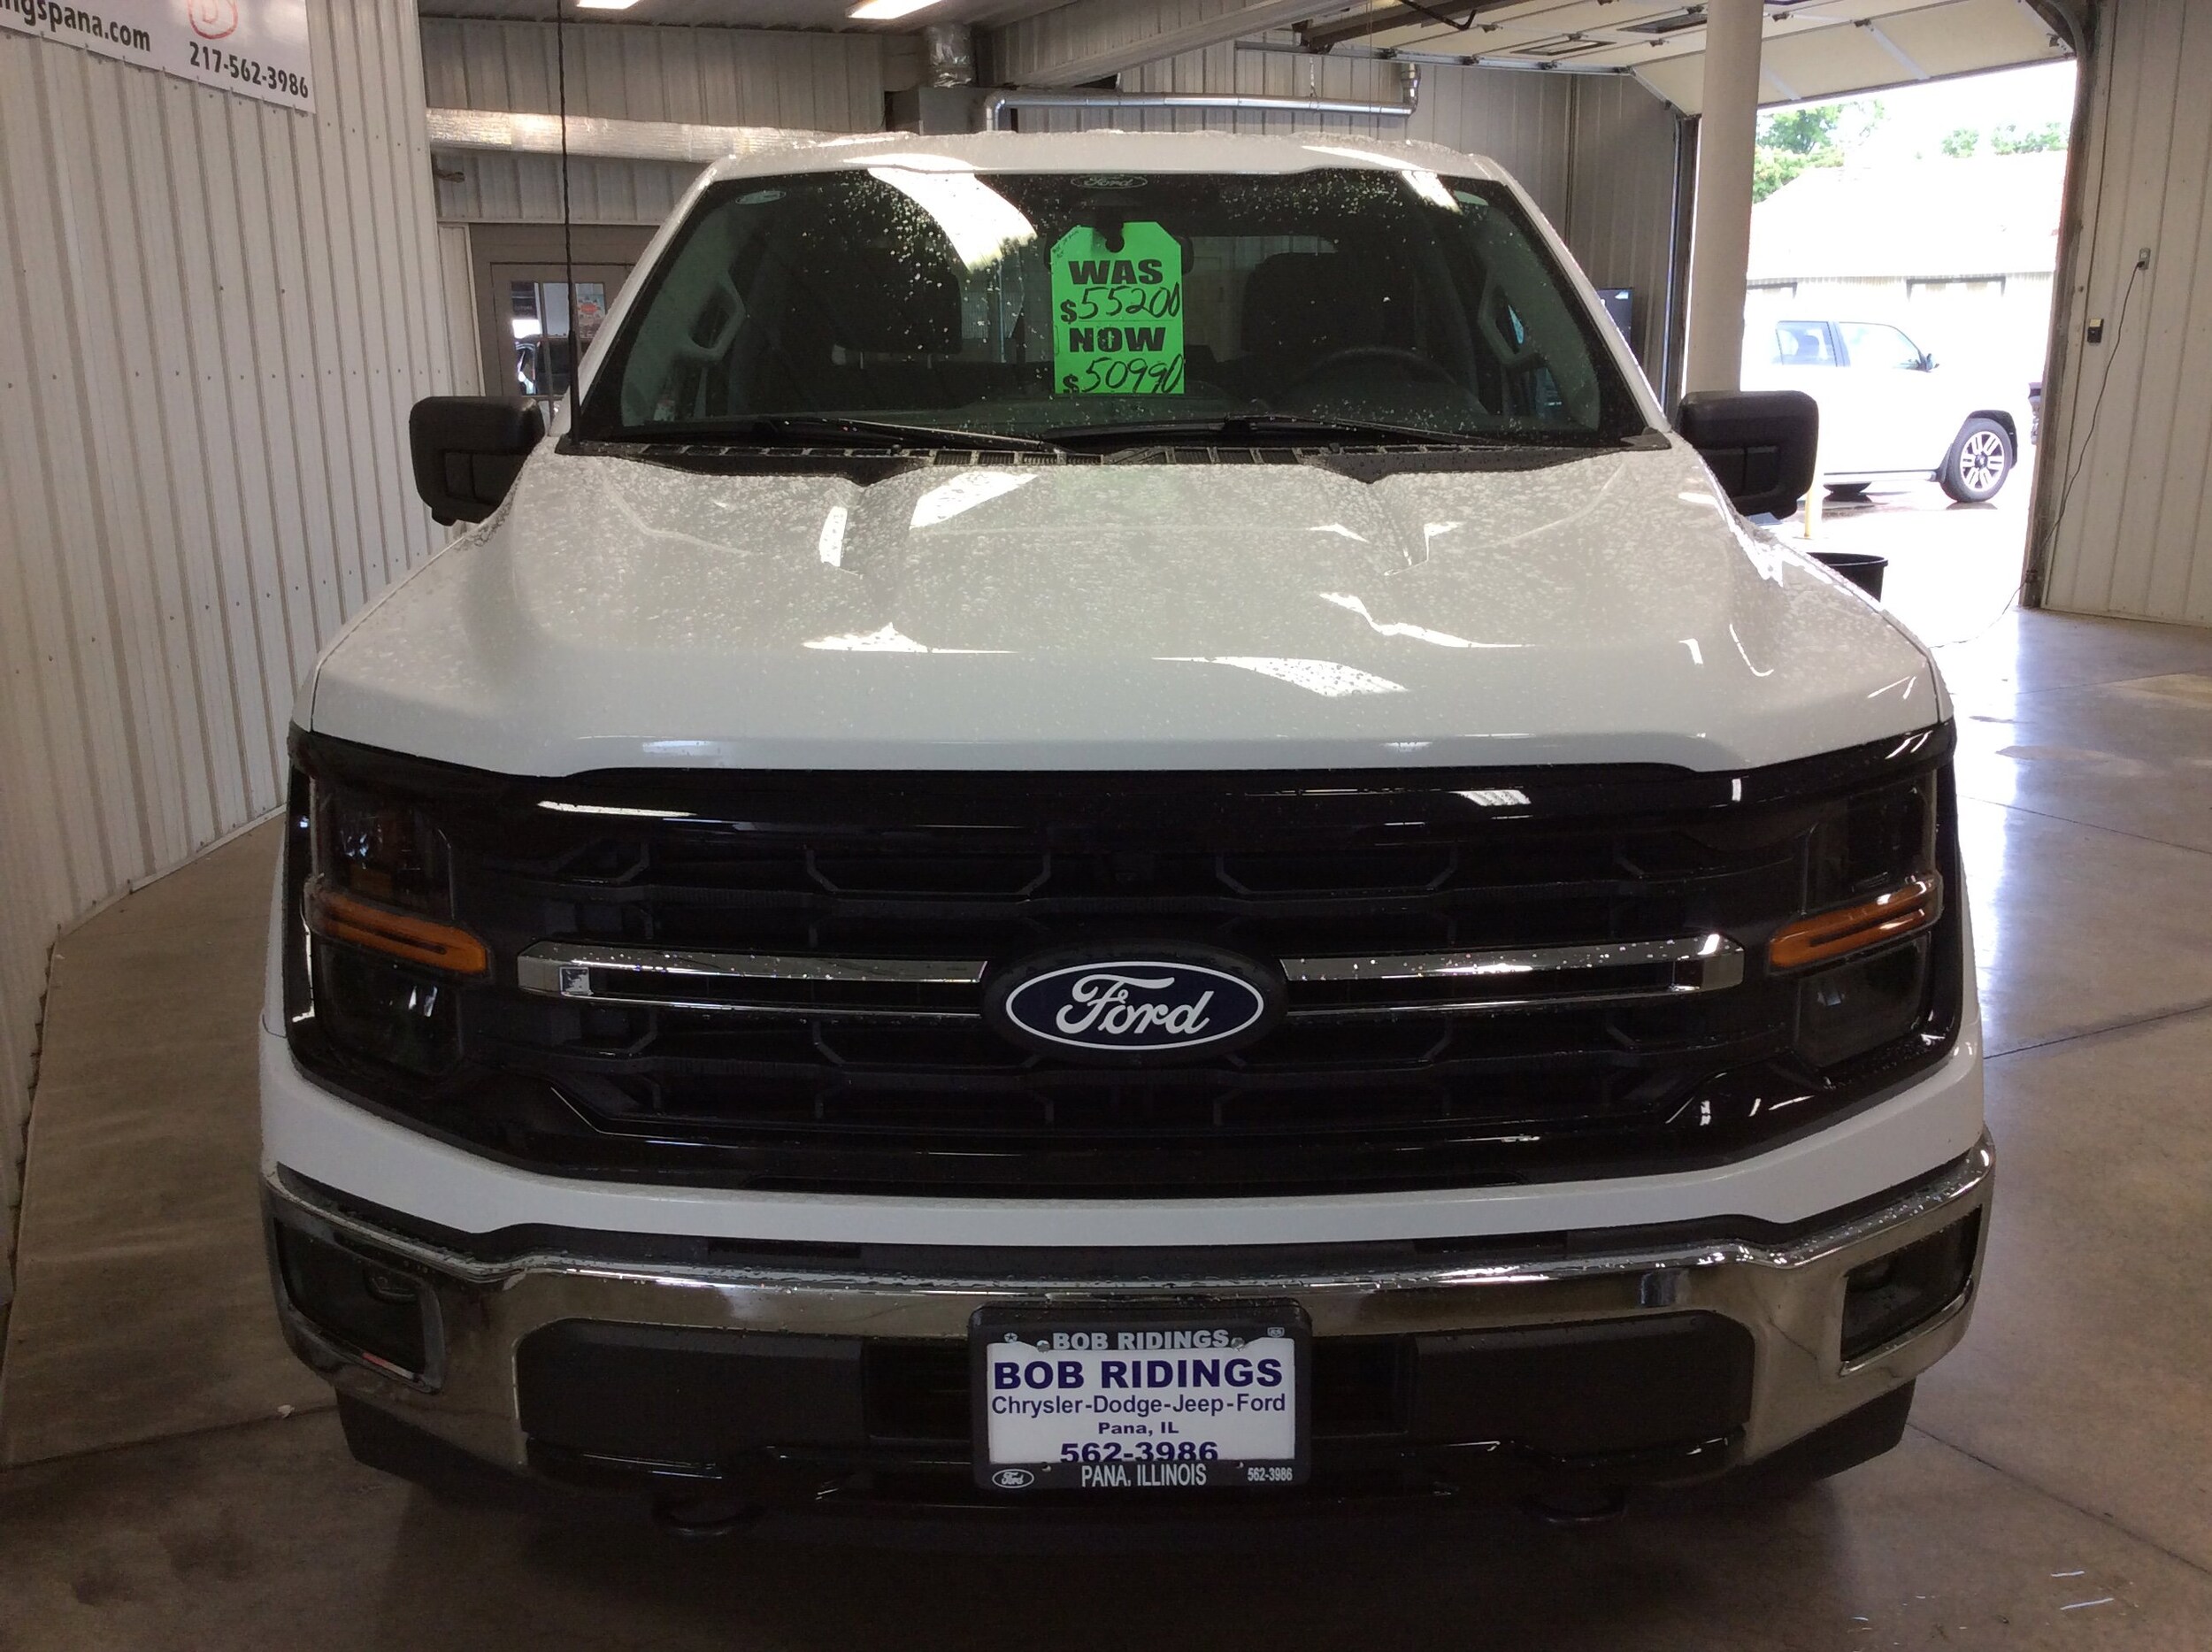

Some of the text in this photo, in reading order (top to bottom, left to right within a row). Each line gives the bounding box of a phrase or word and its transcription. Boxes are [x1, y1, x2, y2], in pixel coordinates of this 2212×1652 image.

[0, 0, 150, 51] gspana.com
[189, 42, 309, 98] 217-562-3986
[1068, 258, 1164, 285] WAS
[1069, 327, 1166, 352] NOW
[1056, 973, 1215, 1034] Ford
[1053, 1330, 1230, 1351] BOB RIDINGS
[994, 1358, 1284, 1390] BOB RIDINGS
[1098, 1421, 1179, 1437] Pana, IL
[1060, 1441, 1218, 1462] 562-3986
[1081, 1463, 1207, 1487] PANA, ILLINOIS
[1247, 1467, 1293, 1482] 562-3986
